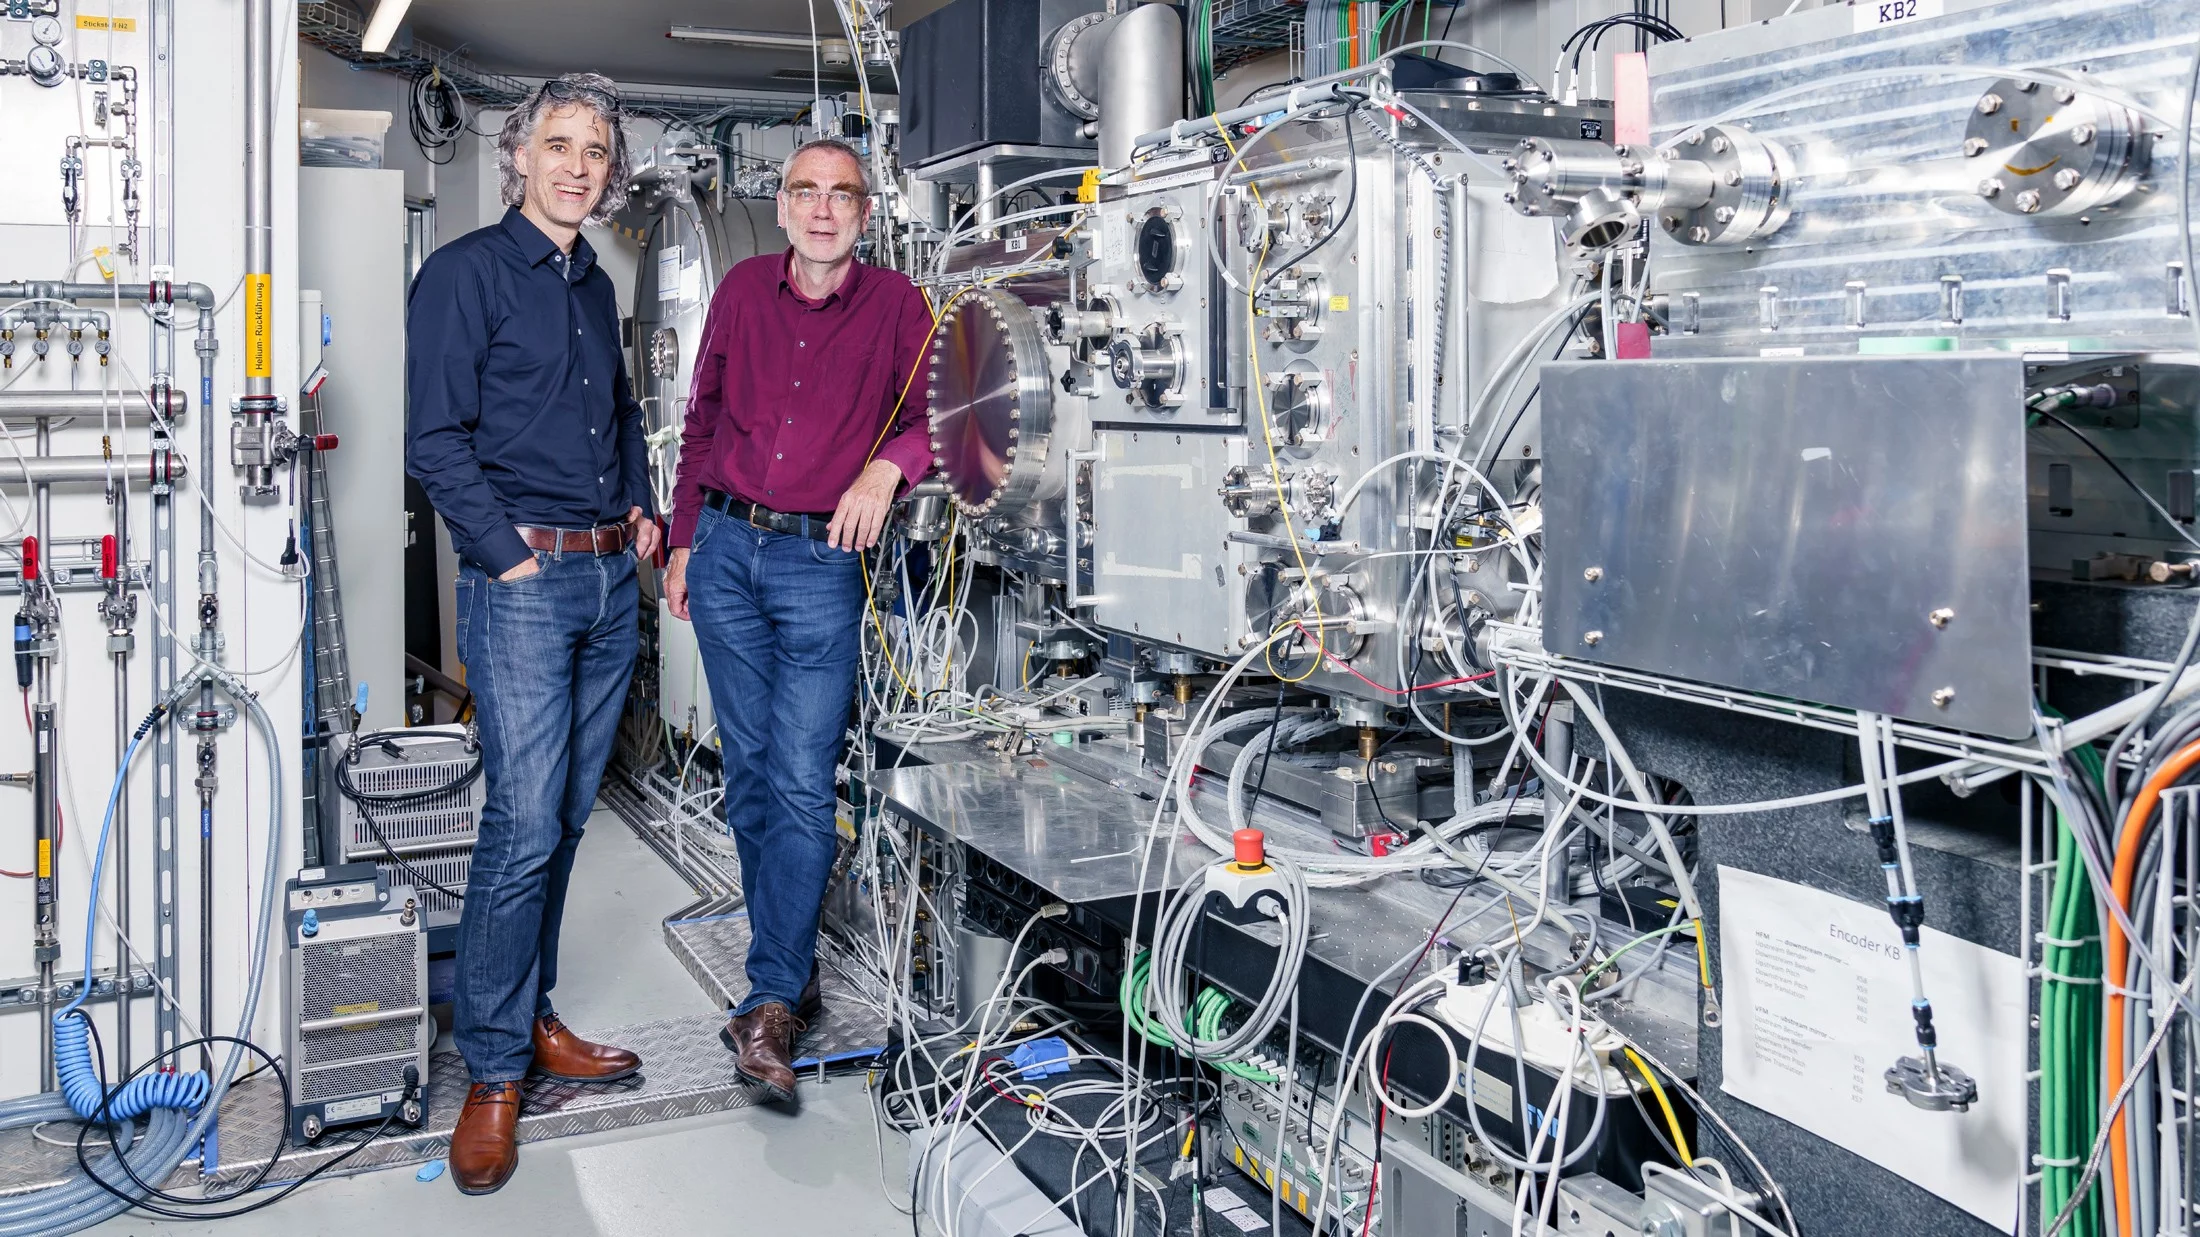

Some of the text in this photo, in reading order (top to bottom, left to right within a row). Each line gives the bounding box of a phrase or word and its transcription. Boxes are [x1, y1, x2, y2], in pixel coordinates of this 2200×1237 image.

[1879, 0, 1917, 23] KB2
[255, 282, 264, 336] Rückführung
[1784, 939, 1822, 957] downstream
[1824, 952, 1842, 964] mirror
[1829, 924, 1901, 960] Encoder KB
